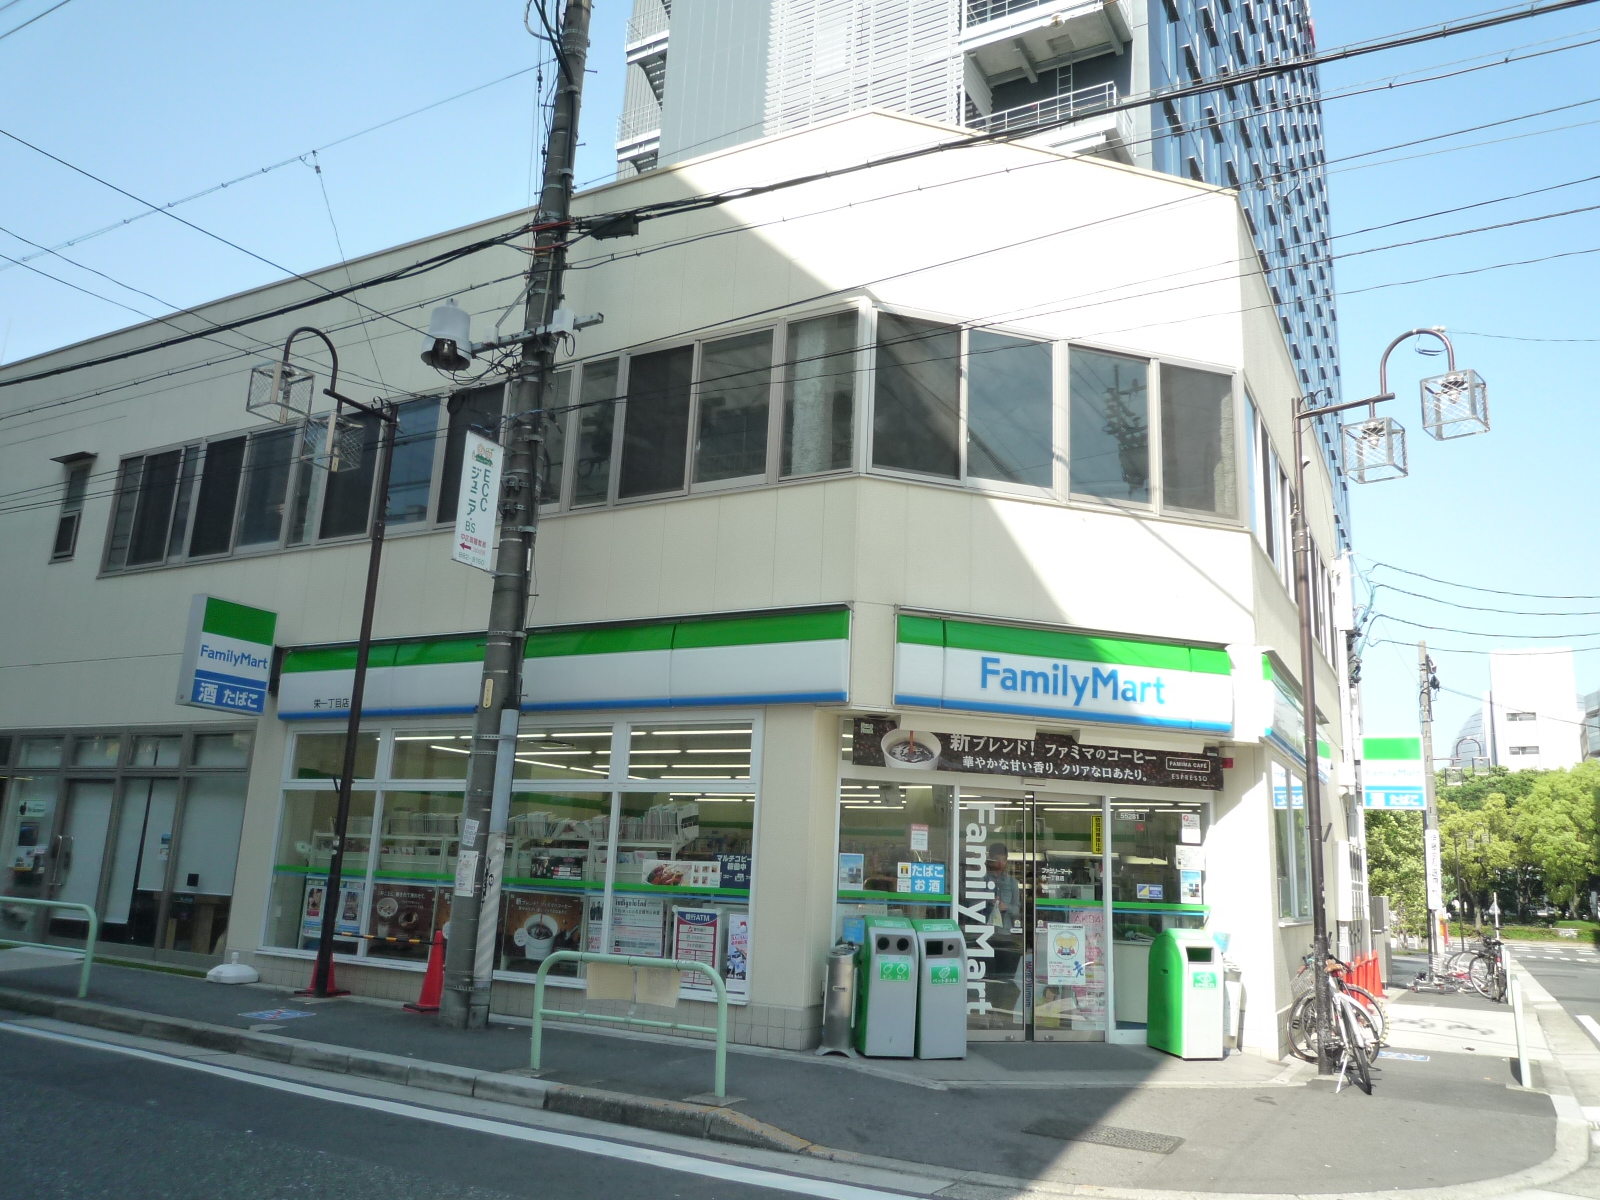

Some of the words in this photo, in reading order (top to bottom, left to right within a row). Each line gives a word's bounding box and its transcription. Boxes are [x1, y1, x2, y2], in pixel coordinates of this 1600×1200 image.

[480, 468, 491, 512] ECC
[200, 644, 267, 670] FamilyMart
[980, 656, 1166, 707] FamilyMart
[198, 682, 217, 705] 酒
[222, 688, 258, 709] たばこ
[1044, 743, 1157, 765] ファミマのコーヒー
[1171, 773, 1208, 782] ESPRESSO
[1120, 812, 1140, 820] 55281
[911, 864, 944, 878] たばこ
[914, 879, 941, 893] お酒
[958, 802, 996, 1016] FamilyMart
